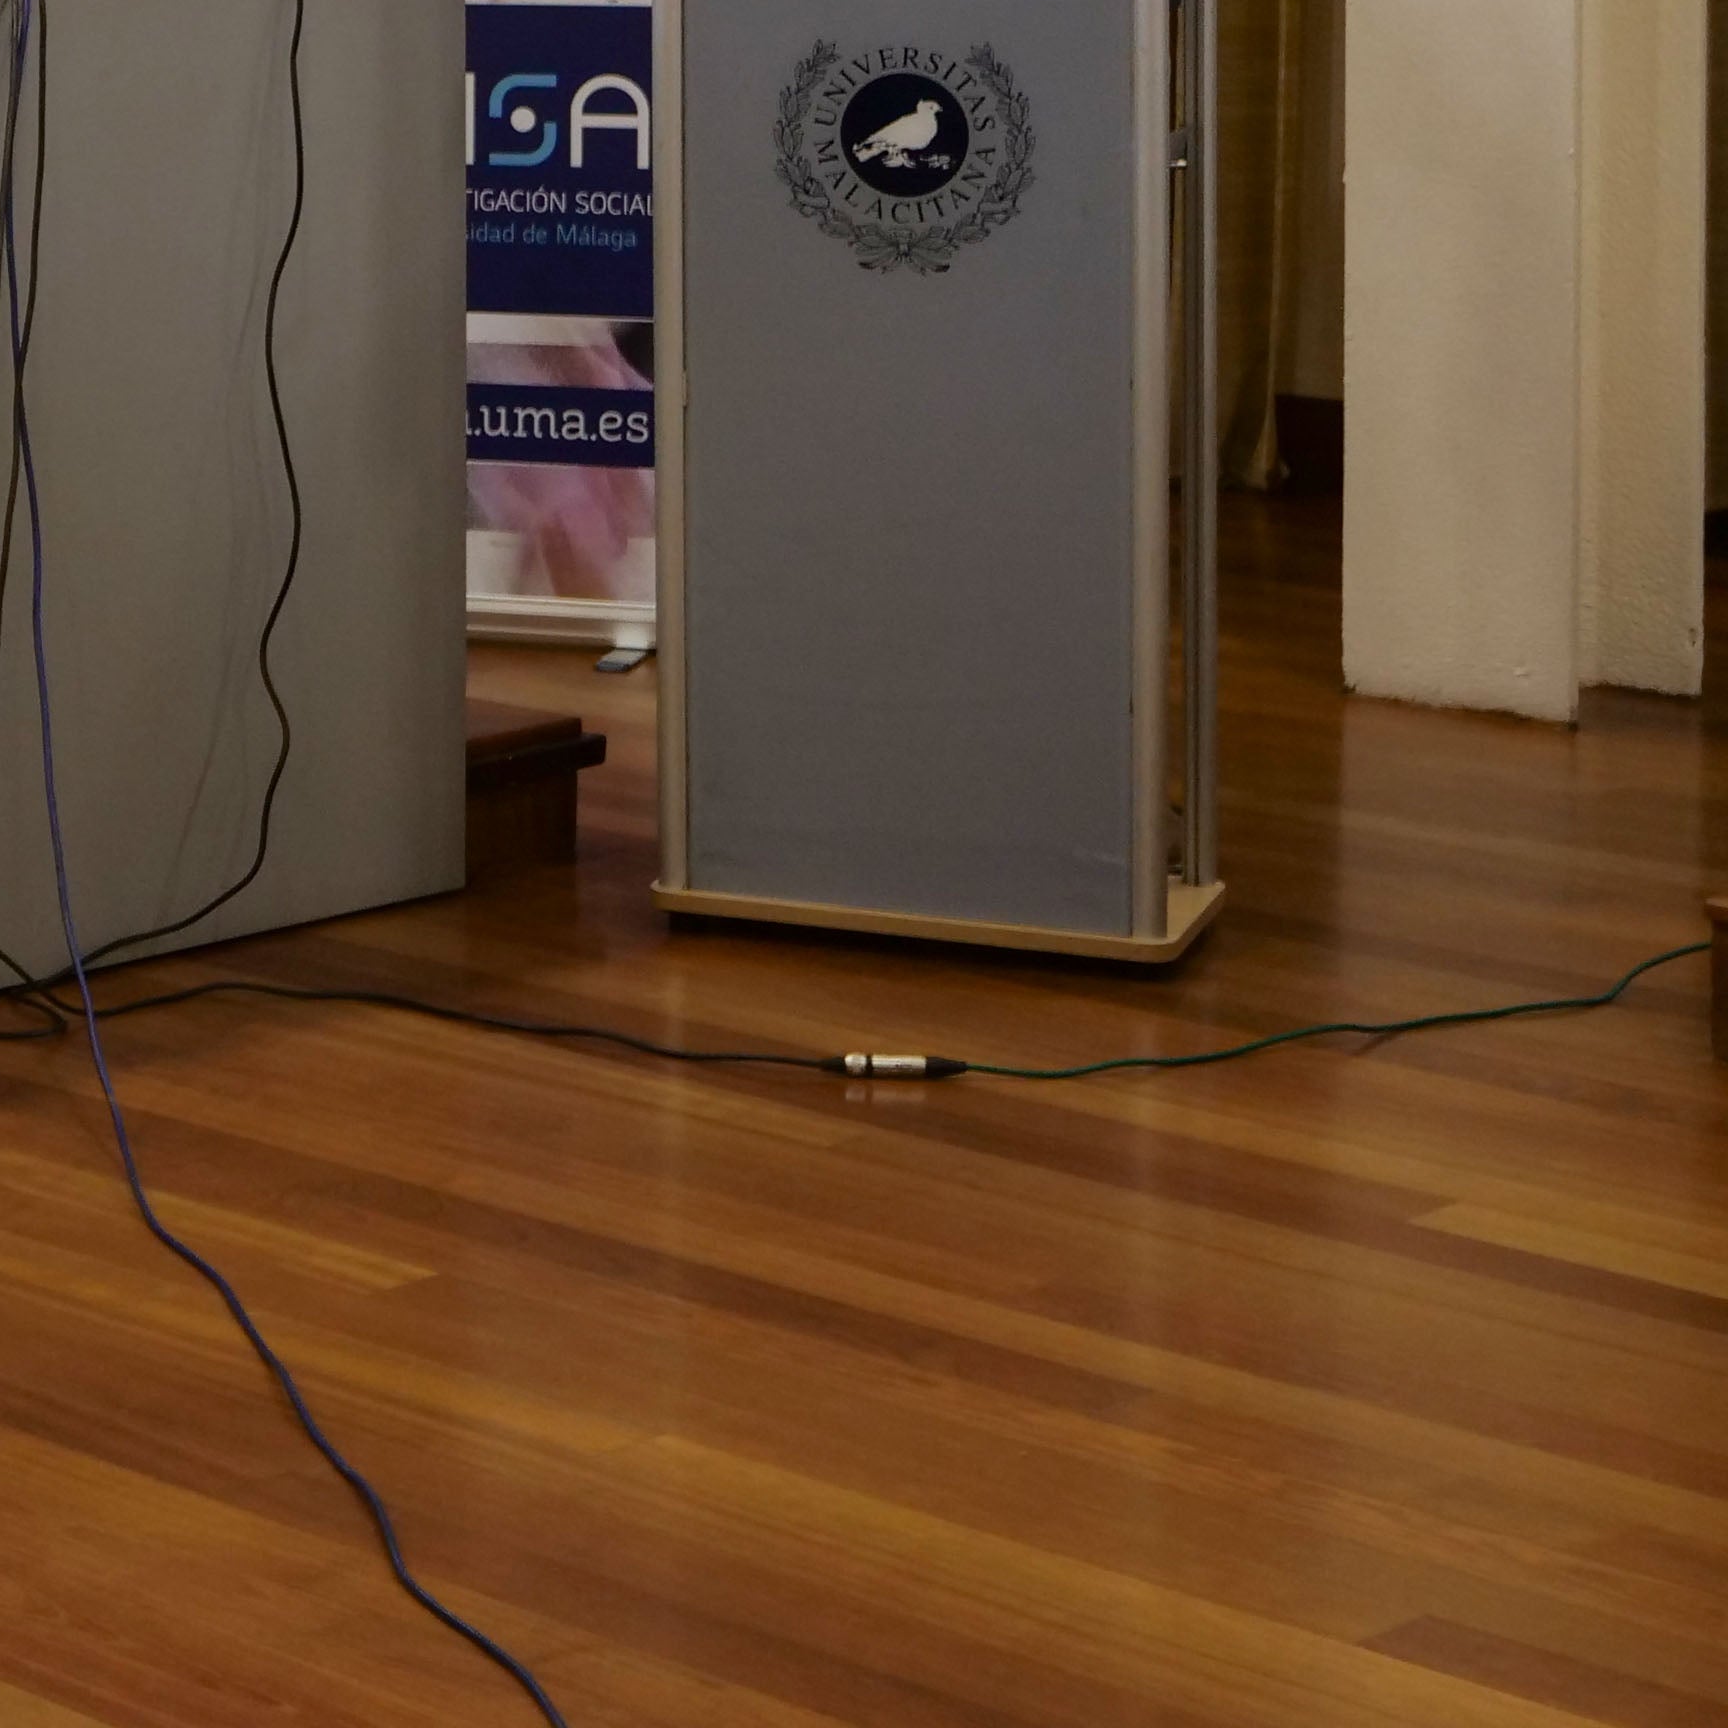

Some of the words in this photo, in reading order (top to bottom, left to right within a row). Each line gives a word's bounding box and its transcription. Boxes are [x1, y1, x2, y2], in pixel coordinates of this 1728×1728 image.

[814, 46, 996, 132] UNIVERSITAS
[575, 190, 653, 216] SOCIAL
[814, 139, 996, 224] MALACITANA
[523, 223, 547, 244] de
[557, 224, 638, 252] Málaga
